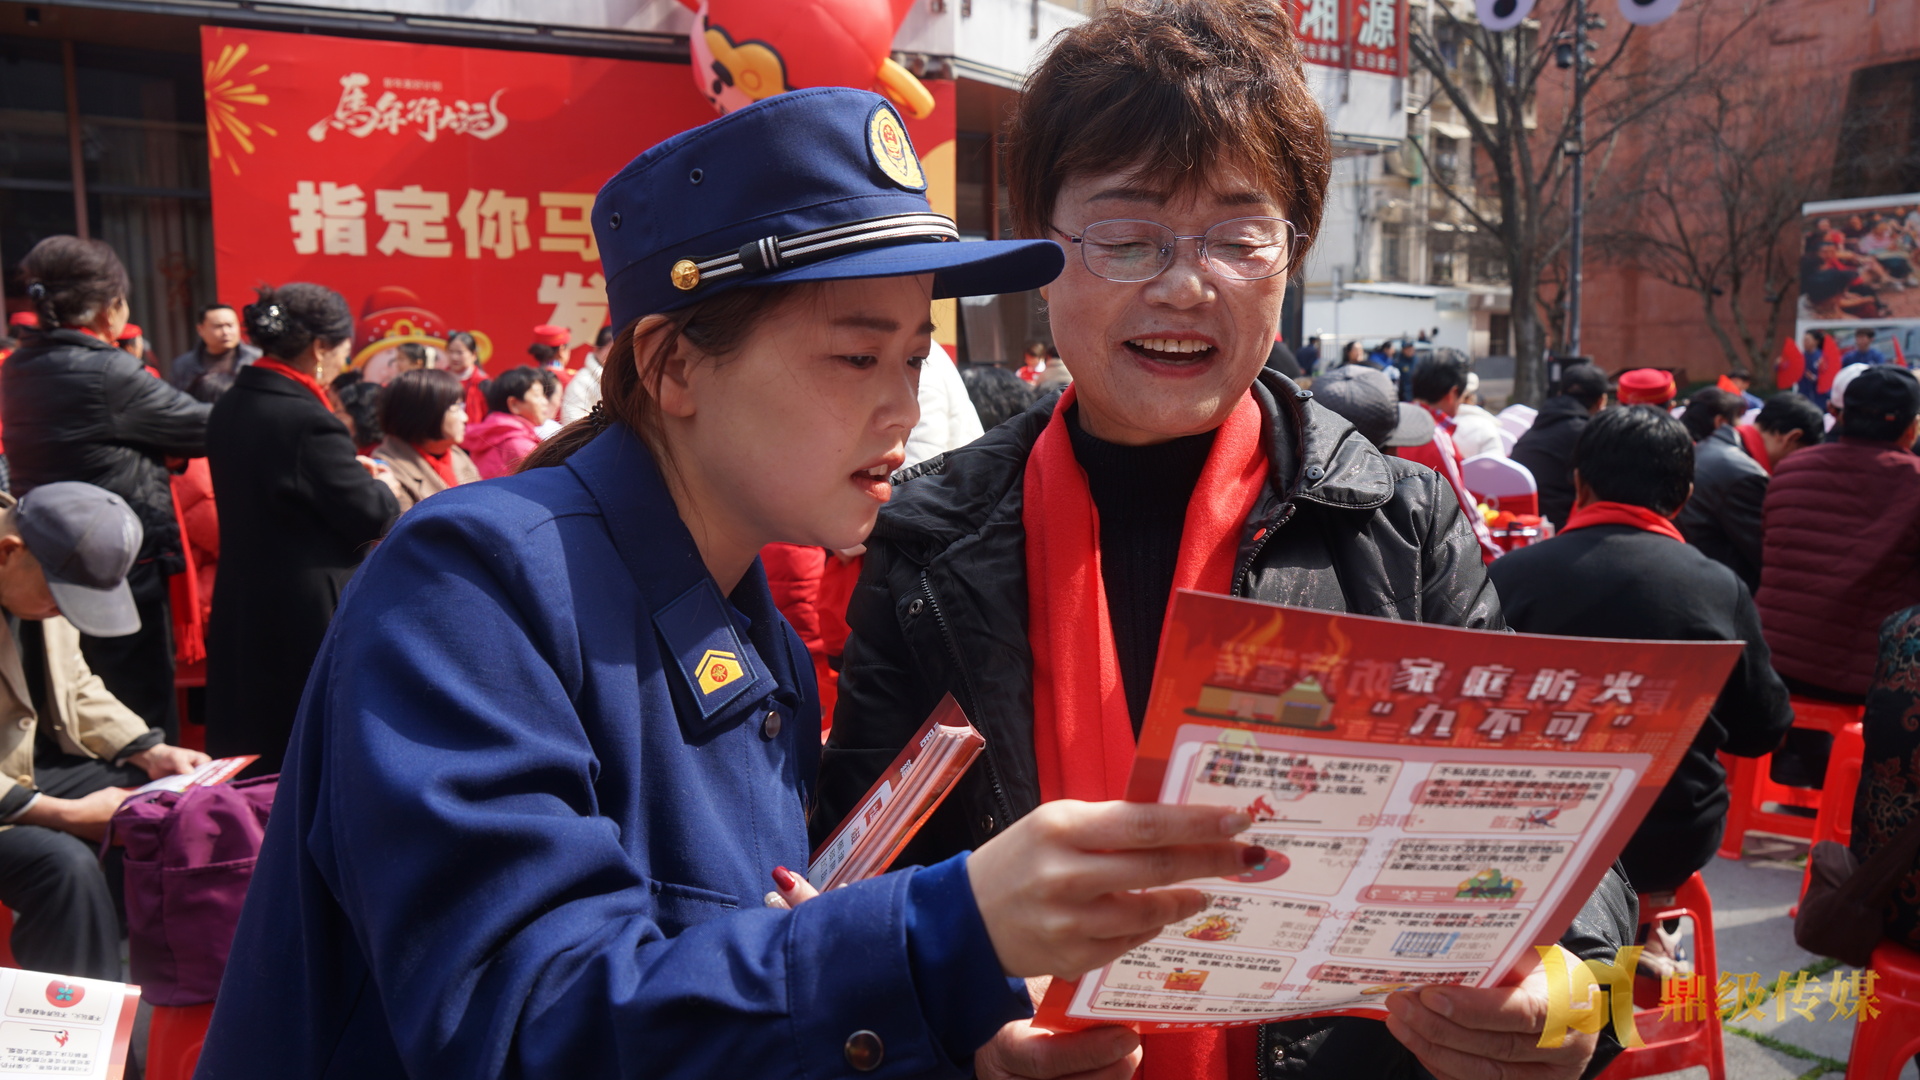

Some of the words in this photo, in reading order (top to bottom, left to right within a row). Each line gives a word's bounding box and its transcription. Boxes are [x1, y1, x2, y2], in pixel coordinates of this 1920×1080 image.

[1299, 0, 1396, 50] 湘源
[288, 180, 600, 262] 指定你马
[1393, 657, 1644, 705] 家庭防火
[1371, 699, 1633, 742] “九不可”
[1131, 945, 1281, 966] 中不可存放超过0.5公升的
